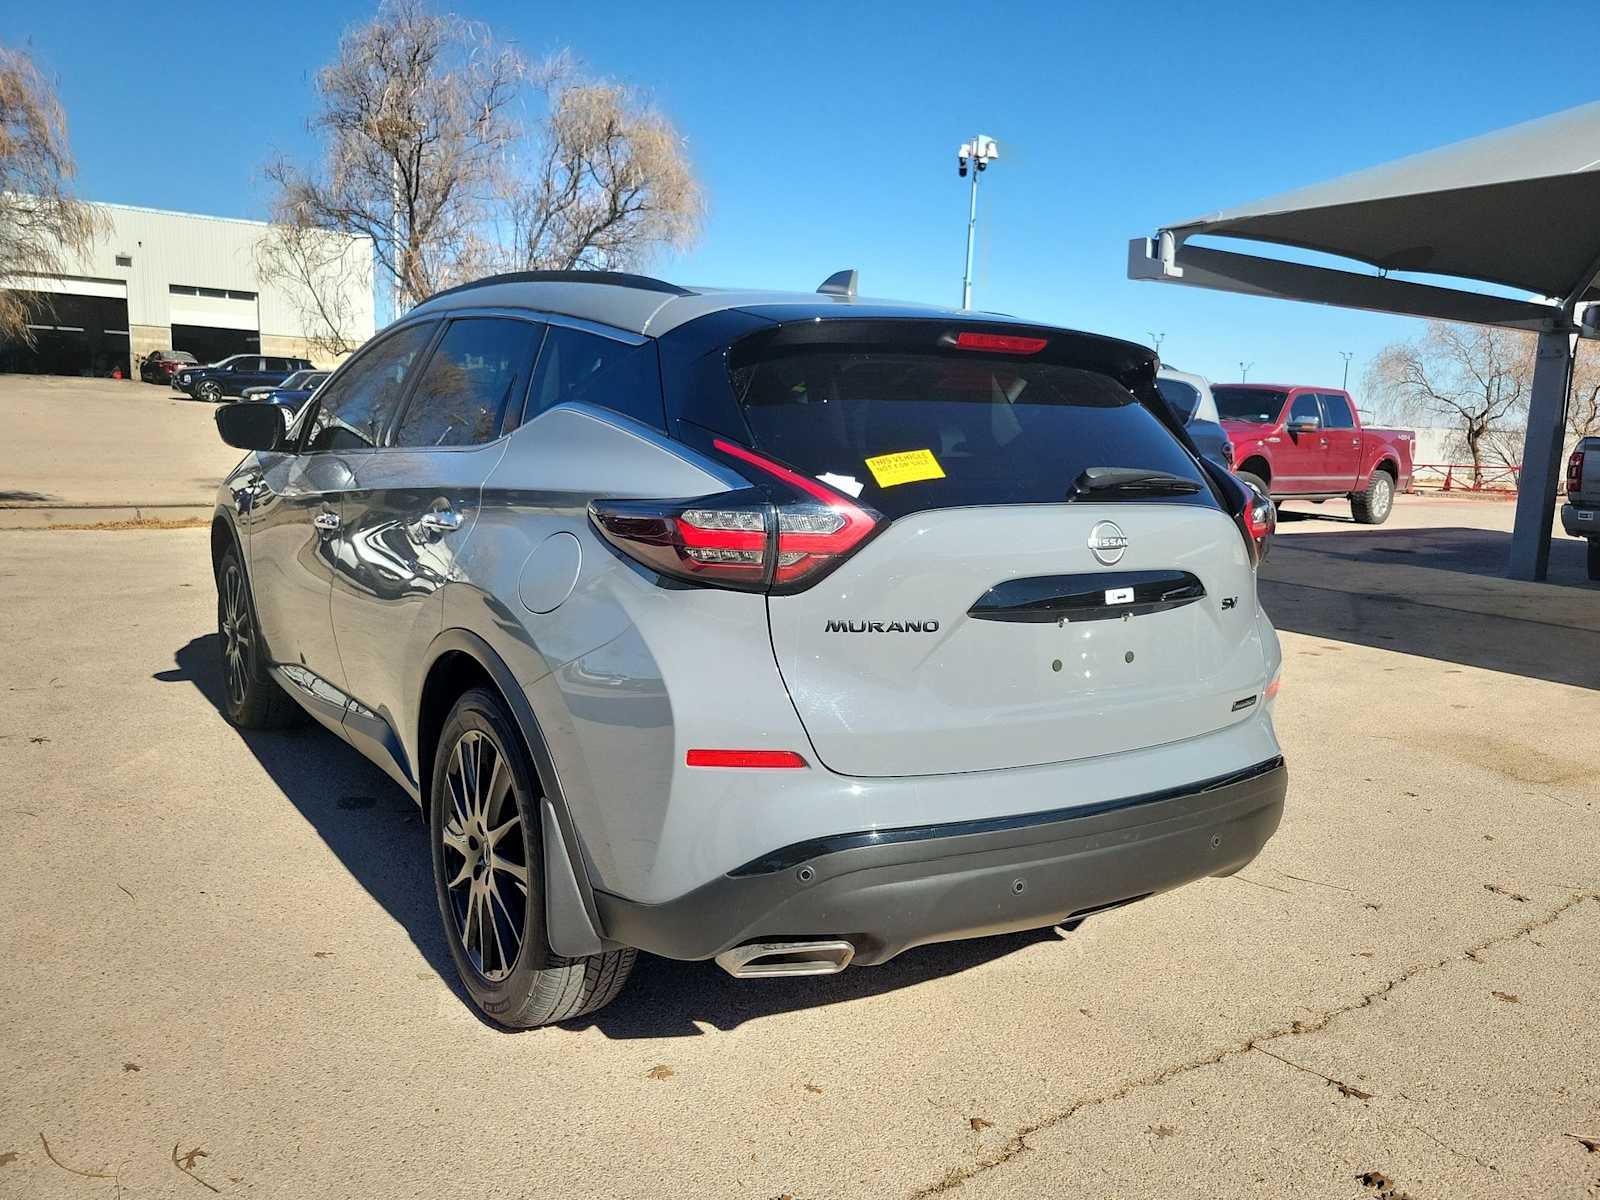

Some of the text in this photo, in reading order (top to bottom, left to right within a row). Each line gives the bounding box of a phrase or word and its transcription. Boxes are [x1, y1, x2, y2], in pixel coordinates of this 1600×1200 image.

[870, 452, 929, 466] THIS VEHICLE
[876, 464, 892, 473] NOT
[1221, 596, 1238, 610] SV
[825, 619, 940, 633] MURANO
